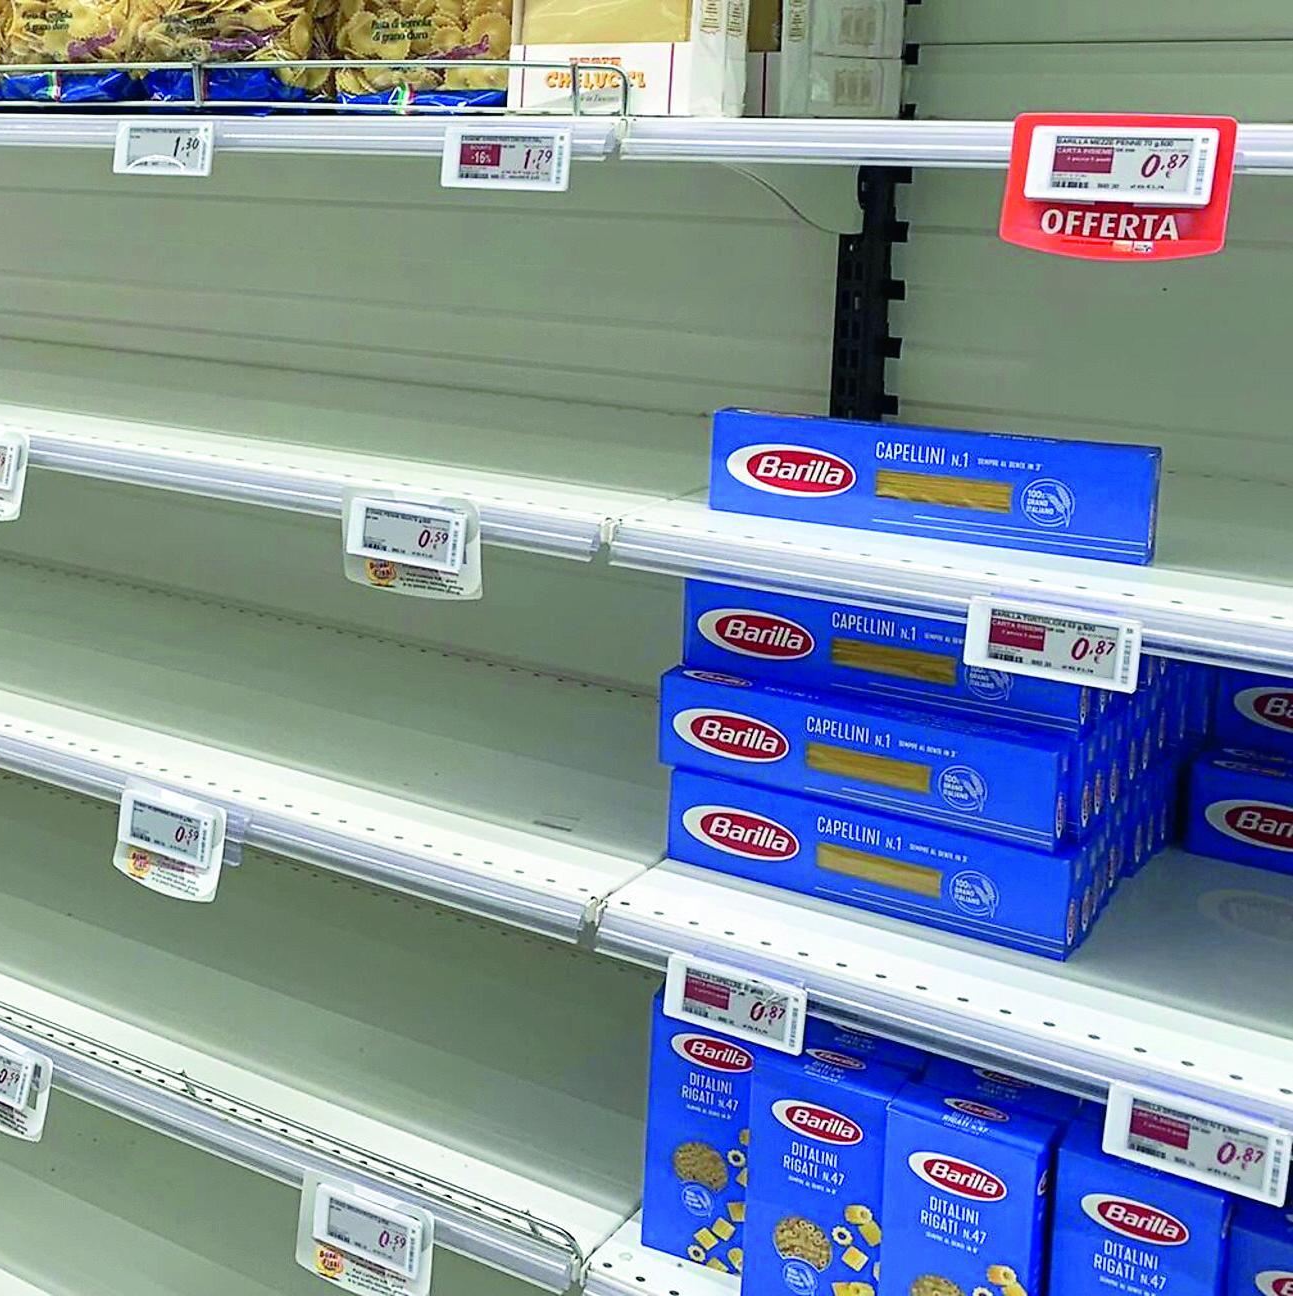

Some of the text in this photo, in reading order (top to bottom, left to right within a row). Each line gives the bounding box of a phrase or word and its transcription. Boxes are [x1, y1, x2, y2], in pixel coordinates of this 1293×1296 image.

[1141, 153, 1189, 178] 0,87
[1040, 208, 1180, 241] OFFERTA
[876, 441, 945, 465] CAPELLINI
[951, 452, 969, 468] N.1
[756, 455, 846, 485] Barilla
[417, 529, 449, 548] 0,59
[724, 619, 805, 651] Barilla
[832, 612, 895, 638] CAPELLINI
[900, 626, 916, 641] N.1
[1071, 636, 1116, 661] 0,87
[699, 719, 780, 754] Barilla
[806, 716, 870, 744] CAPELLINI
[874, 733, 891, 749] N.1
[709, 816, 790, 853] Barilla
[816, 815, 880, 846] CAPELLINI
[885, 835, 902, 851] N.1
[689, 1041, 748, 1068] Barilla
[681, 1084, 739, 1111] RIGATI N.47
[689, 1072, 733, 1096] DITALINI
[792, 1108, 856, 1139] Barilla
[791, 1141, 838, 1169] DITALINI
[1217, 1141, 1264, 1165] 0,87
[783, 1155, 818, 1179] RIGATI
[822, 1169, 845, 1187] N.47
[930, 1162, 999, 1195] Barilla
[929, 1196, 979, 1226] DITALINI
[1105, 1204, 1180, 1239] Barilla
[920, 1209, 958, 1236] RIGATI
[962, 1228, 987, 1245] N.47
[1103, 1240, 1159, 1270] DITALINI
[1094, 1253, 1135, 1281] RIGATI
[1140, 1272, 1167, 1290] N.47
